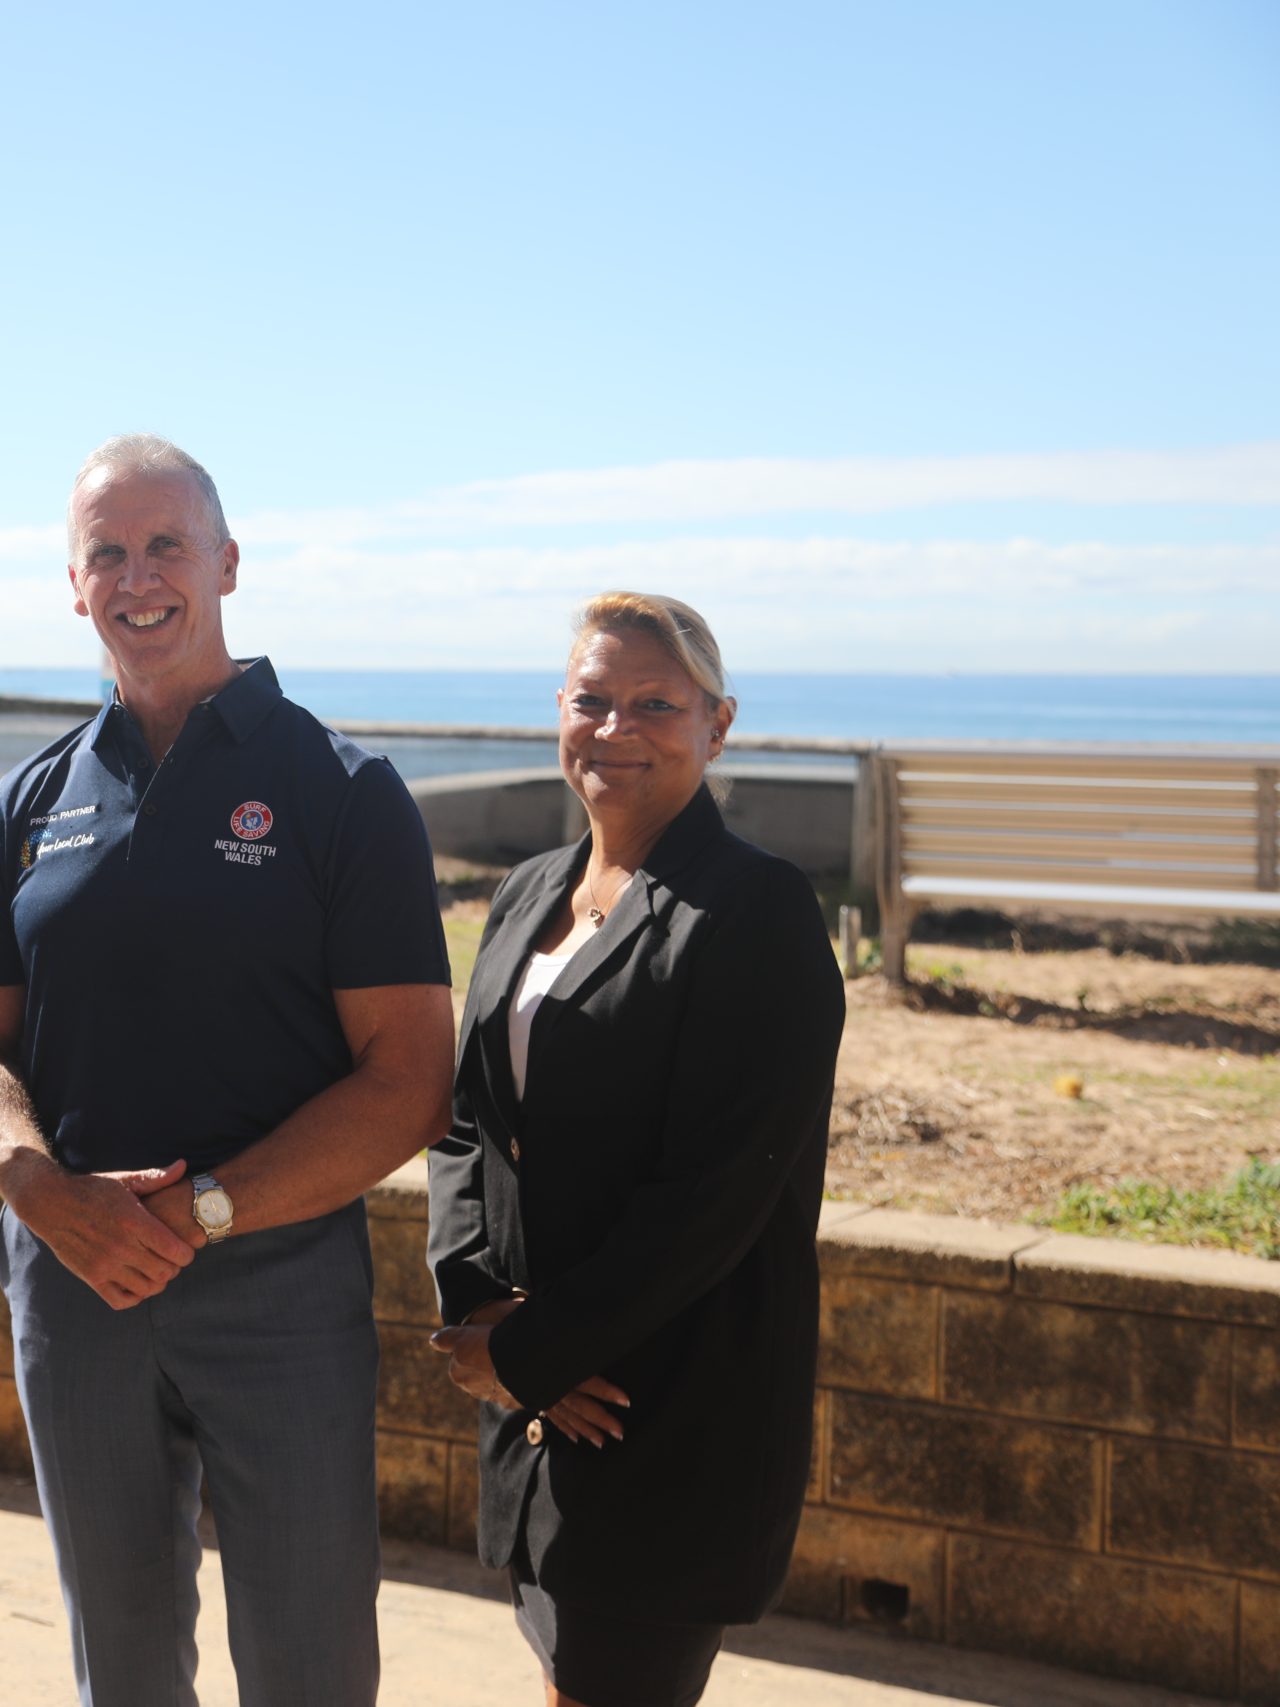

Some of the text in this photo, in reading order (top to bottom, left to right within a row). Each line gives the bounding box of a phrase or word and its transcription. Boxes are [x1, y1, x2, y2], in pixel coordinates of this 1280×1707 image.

[30, 805, 96, 826] PROUD PARTNER
[243, 804, 266, 813] SURF
[233, 816, 270, 838] LIFE SAVING
[36, 833, 95, 860] Your Local Club
[214, 839, 277, 857] NEW SOUTH
[225, 851, 262, 866] WALES
